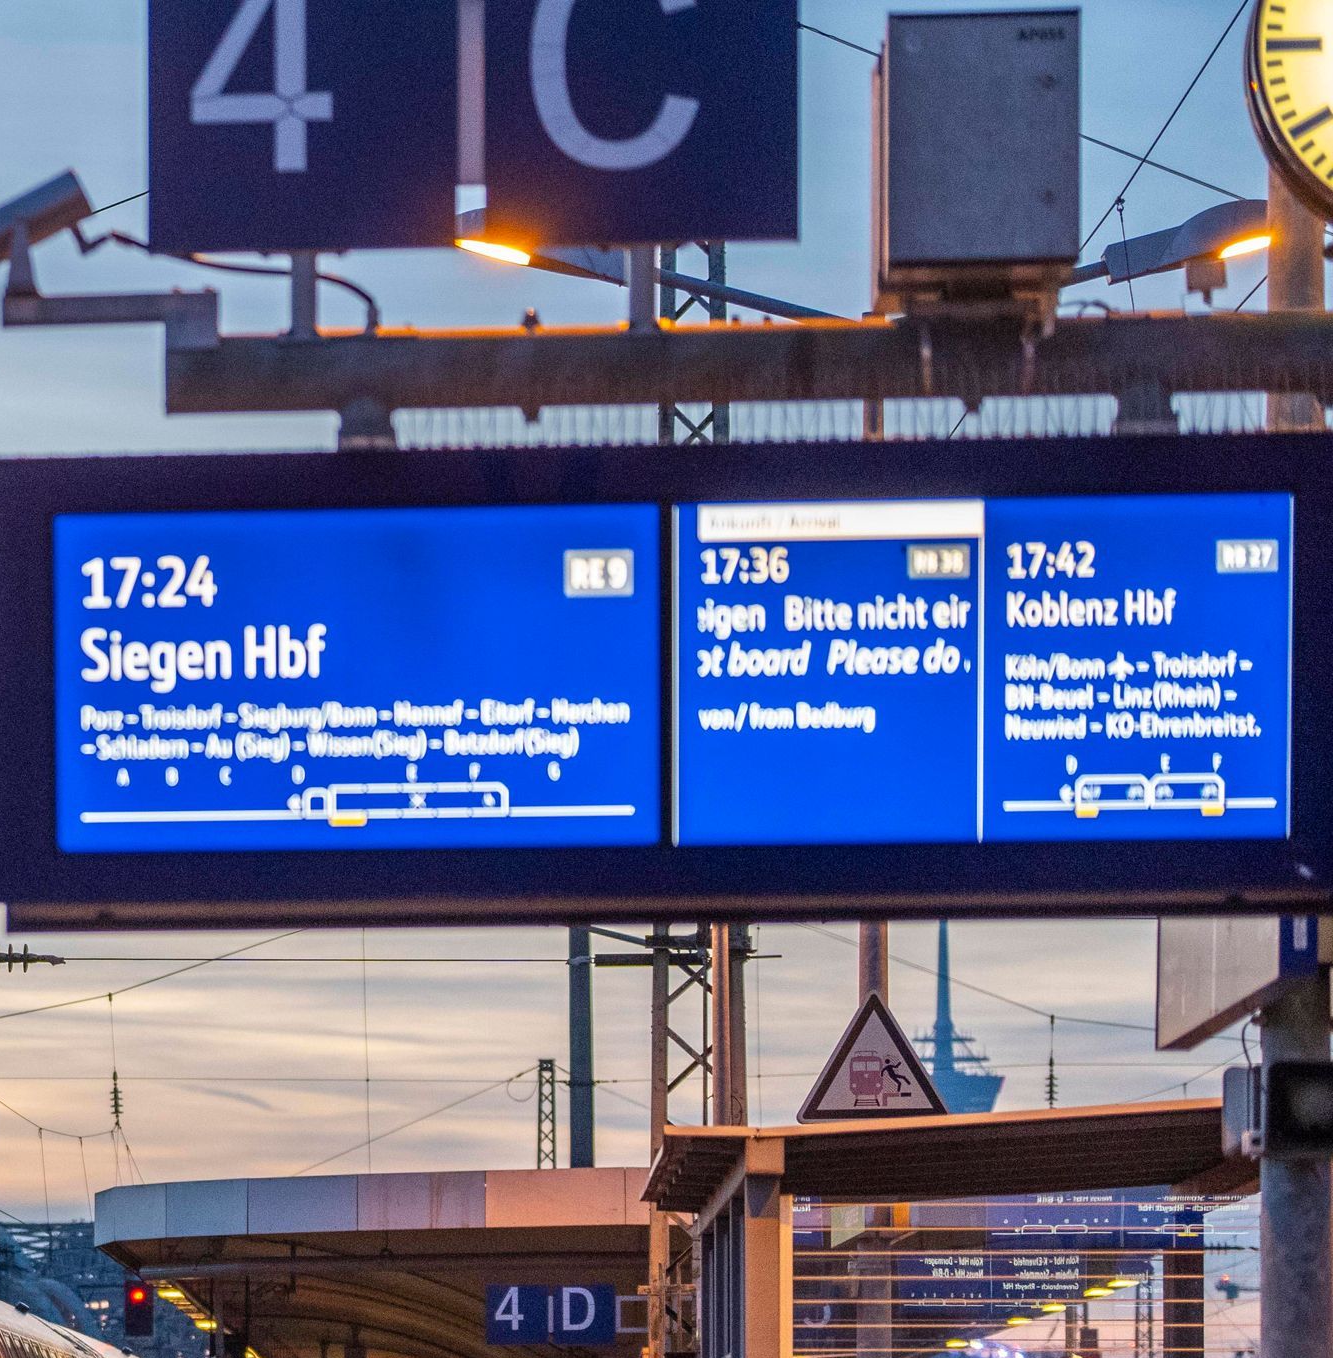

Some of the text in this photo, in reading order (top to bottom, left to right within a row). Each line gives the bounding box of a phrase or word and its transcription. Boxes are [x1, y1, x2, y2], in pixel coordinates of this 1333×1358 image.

[190, 0, 700, 172] 4 C
[701, 547, 789, 584] 17:36
[1007, 541, 1095, 579] 17:42
[82, 555, 217, 609] 17:24
[785, 595, 852, 631] Bitte
[858, 594, 928, 629] nicht
[1007, 588, 1176, 627] Koblenz Hbf
[81, 624, 326, 693] Siegen Hbf
[727, 640, 811, 676] board
[827, 639, 919, 675] Please
[923, 638, 960, 674] do
[495, 1286, 597, 1331] 4 D
